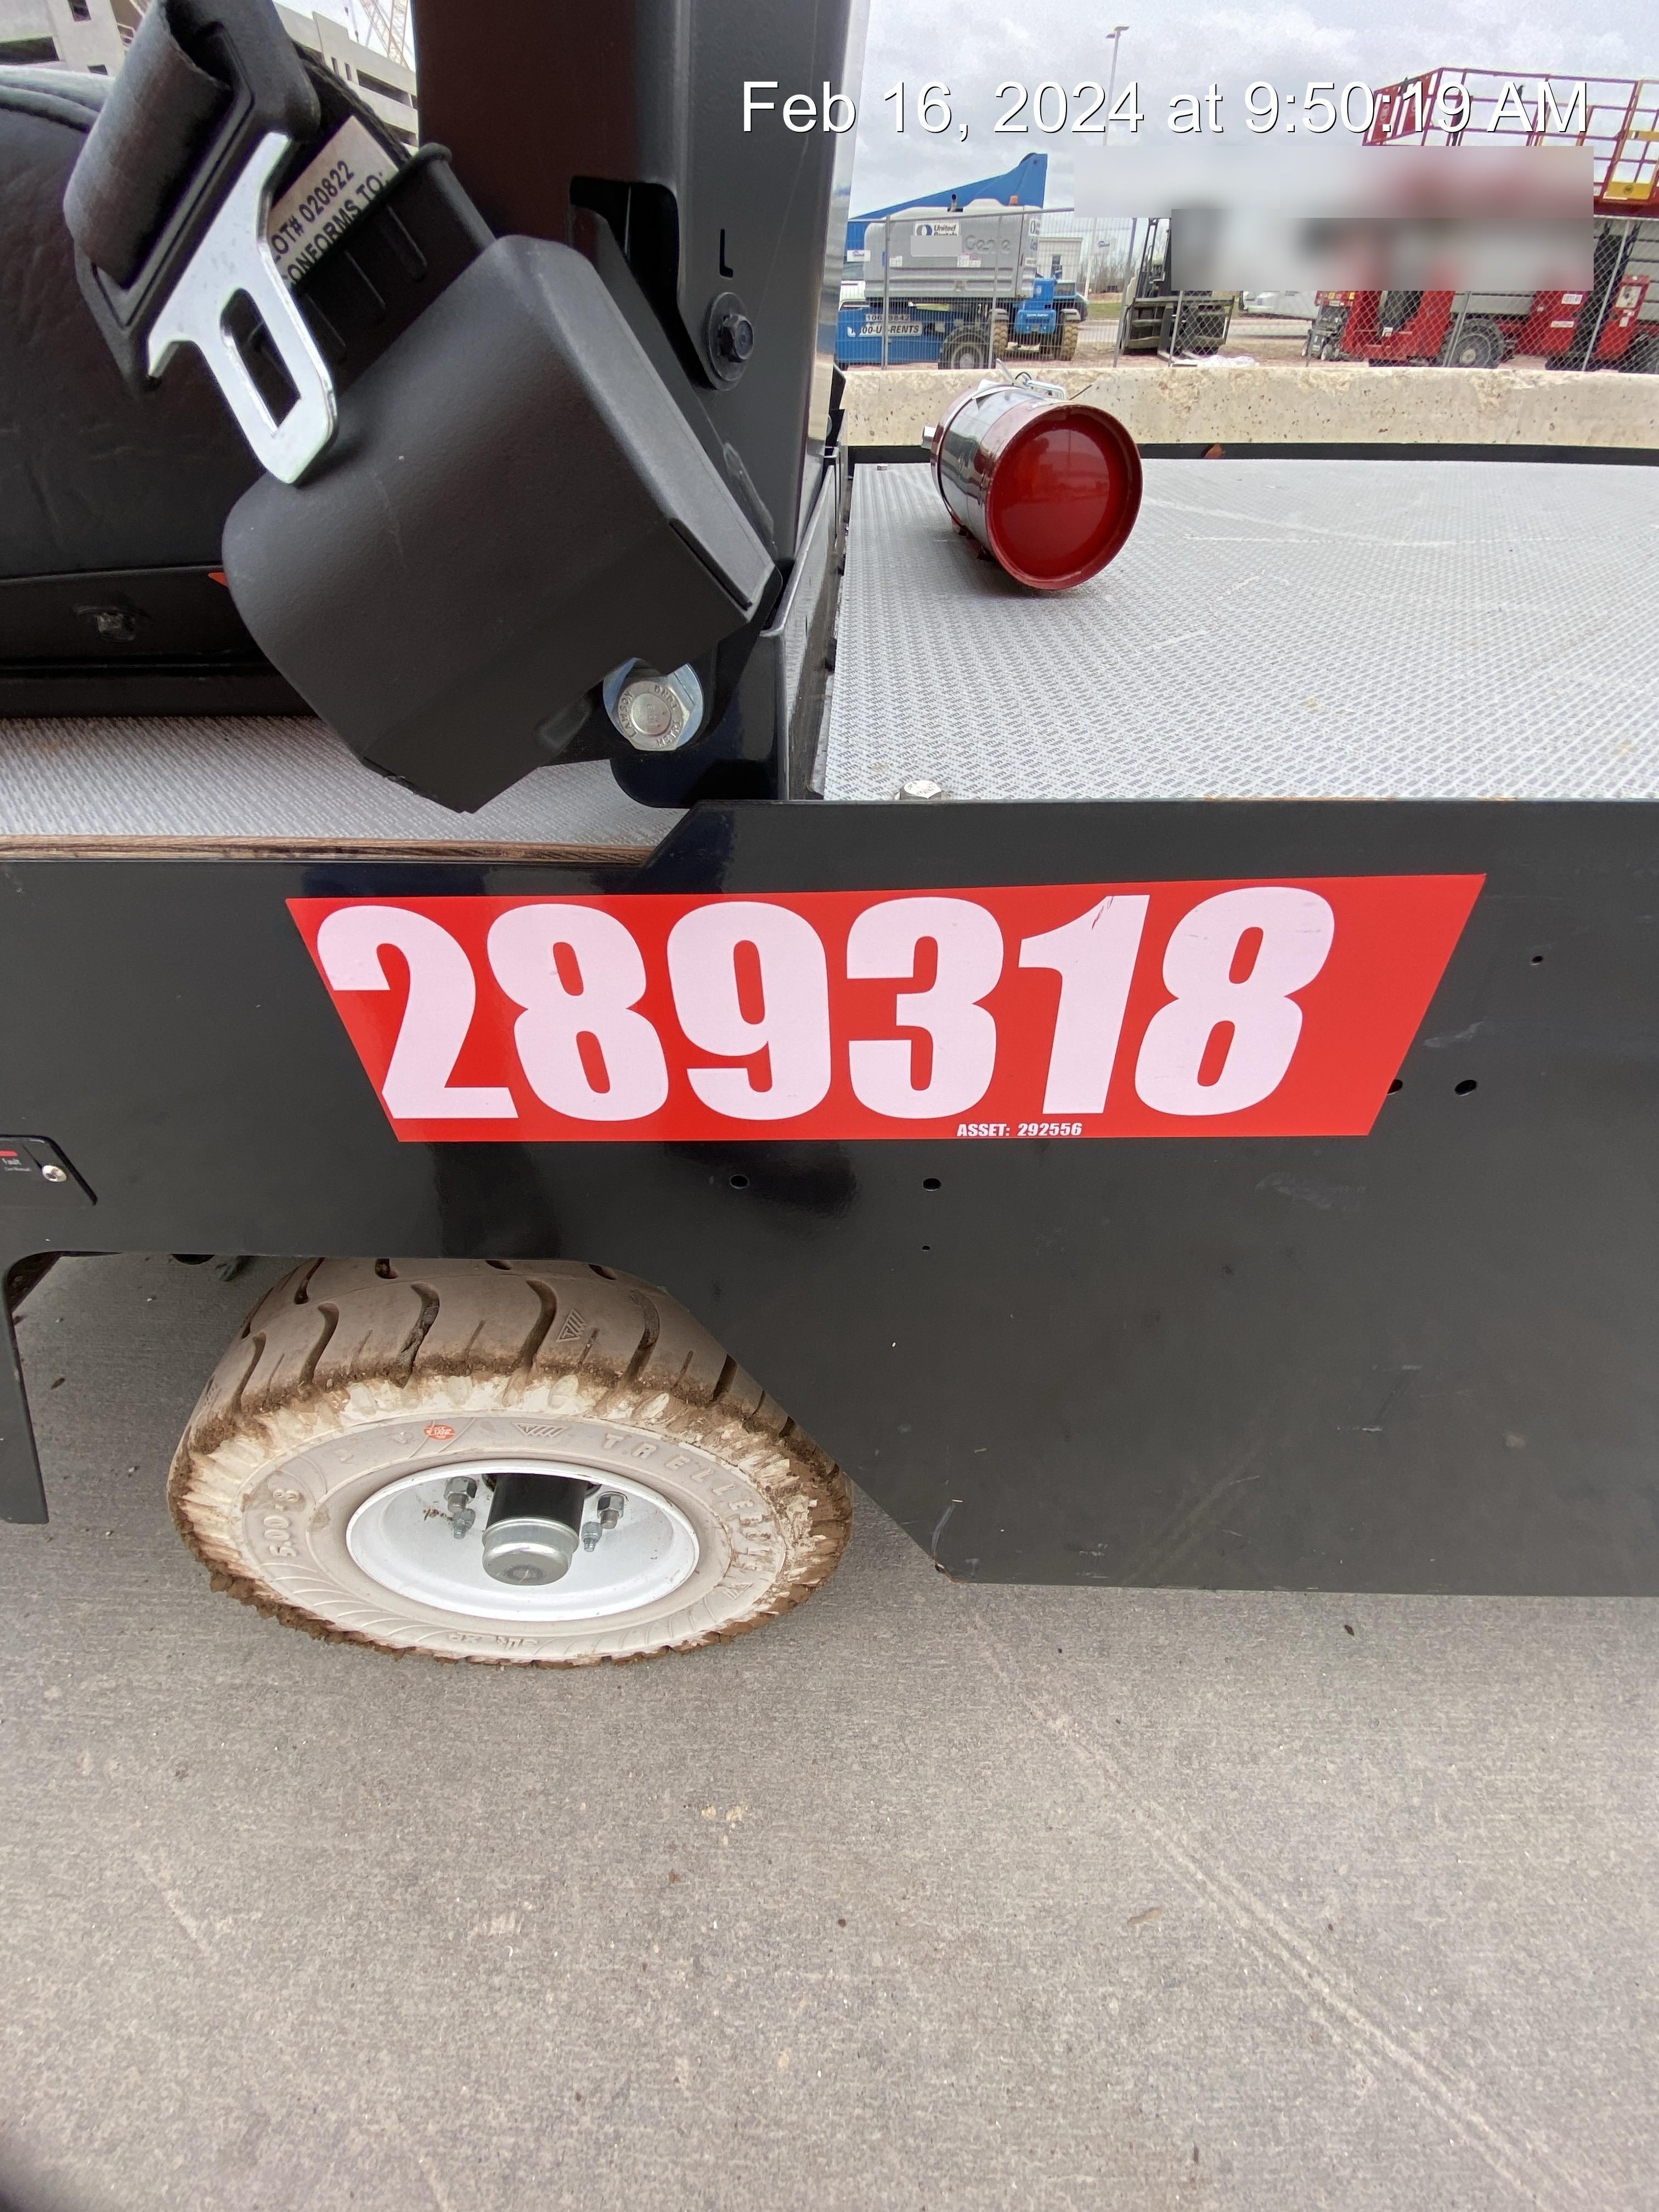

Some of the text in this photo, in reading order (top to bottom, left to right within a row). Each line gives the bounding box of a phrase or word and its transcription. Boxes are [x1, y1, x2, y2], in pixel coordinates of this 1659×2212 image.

[271, 161, 354, 262] OT# 020822
[283, 199, 361, 283] ONFORMS
[965, 234, 1011, 251] Gene
[619, 690, 638, 737] LAWSON
[317, 887, 1335, 1121] 289318
[956, 1122, 1083, 1137] ASSET: 292556
